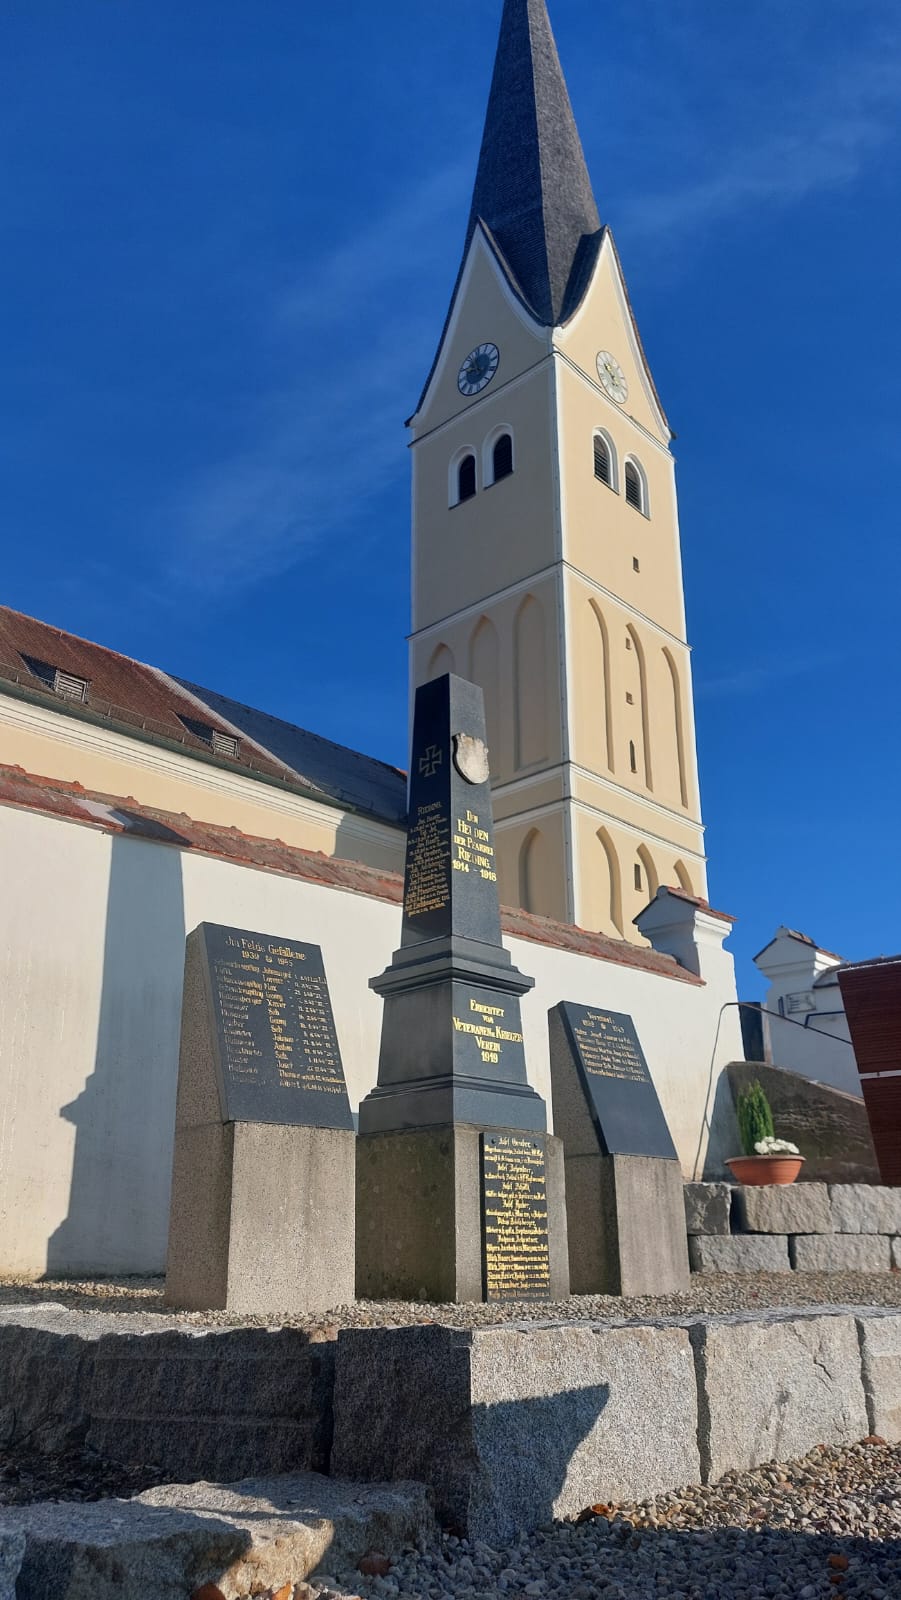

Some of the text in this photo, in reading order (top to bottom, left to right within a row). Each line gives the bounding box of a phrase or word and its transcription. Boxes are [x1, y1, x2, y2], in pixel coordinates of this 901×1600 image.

[466, 810, 478, 824] DEN
[454, 835, 465, 846] DER
[452, 860, 469, 872] 1914
[480, 869, 497, 882] 1918
[481, 1051, 498, 1063] 1919
